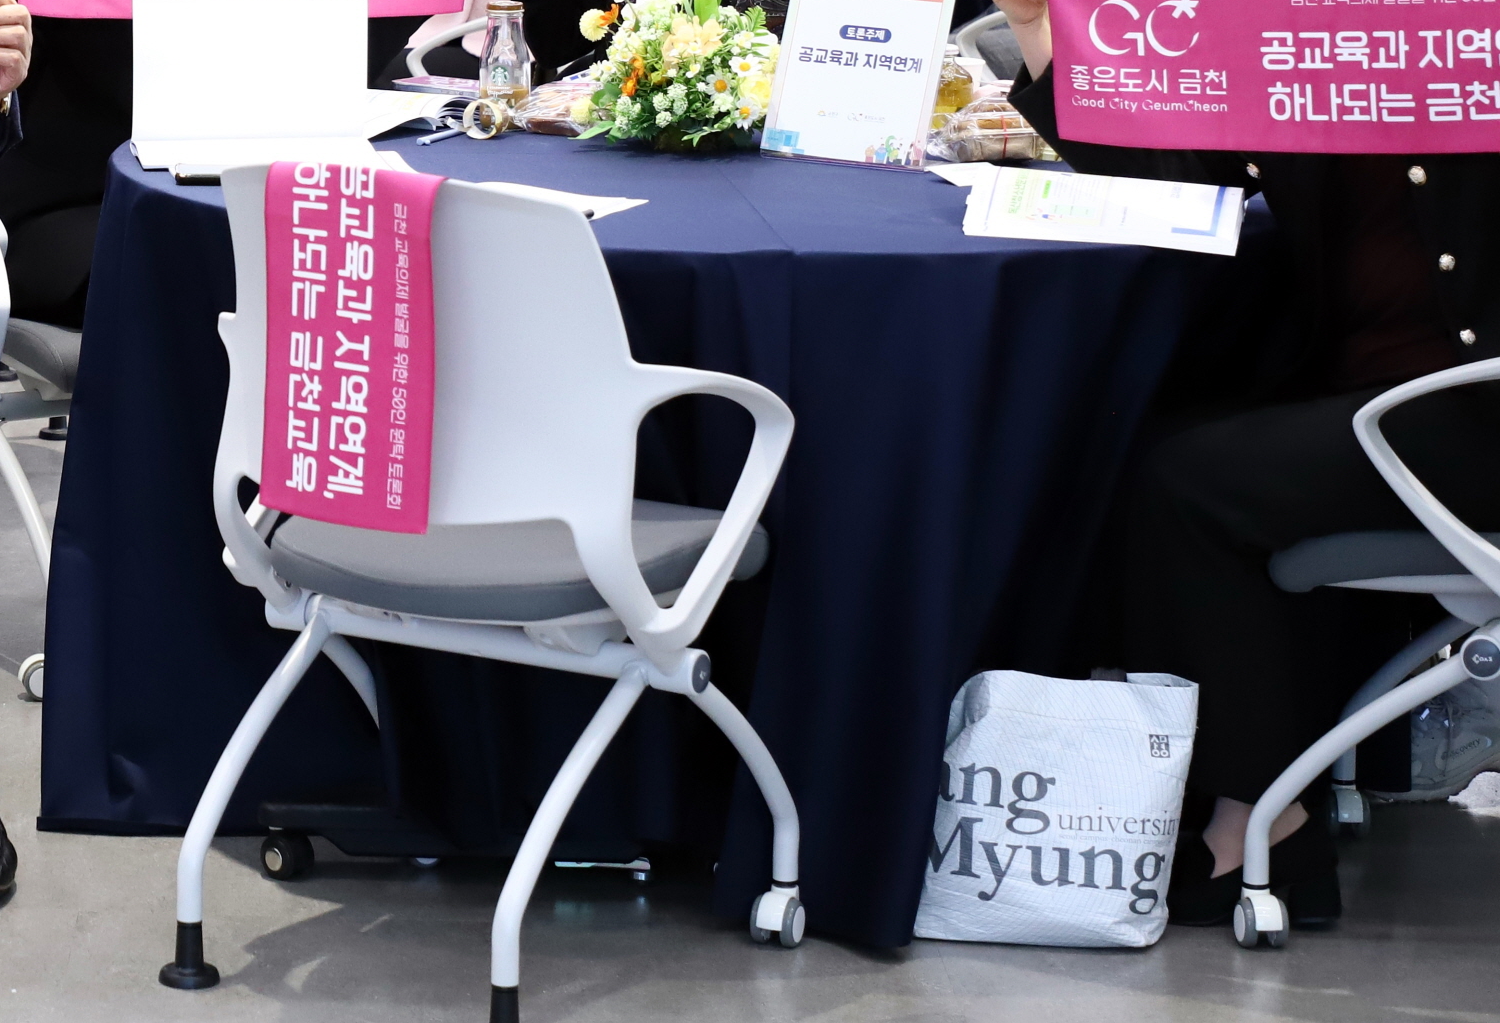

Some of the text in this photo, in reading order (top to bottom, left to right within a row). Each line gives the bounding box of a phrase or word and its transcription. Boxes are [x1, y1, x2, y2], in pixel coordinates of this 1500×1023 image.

[846, 28, 885, 40] 토론주제
[1261, 31, 1409, 70] 공교육과
[799, 46, 922, 74] 공교육과 지역연계
[1070, 65, 1227, 95] 좋은도시 금천
[1268, 82, 1414, 123] 하나되는
[286, 163, 330, 493] 하나되는 금천교육
[387, 203, 409, 510] 금천 교육의제 발굴을 위한 50인 원탁 토론회
[324, 331, 371, 499] 지역연계,
[926, 816, 1165, 915] Myung
